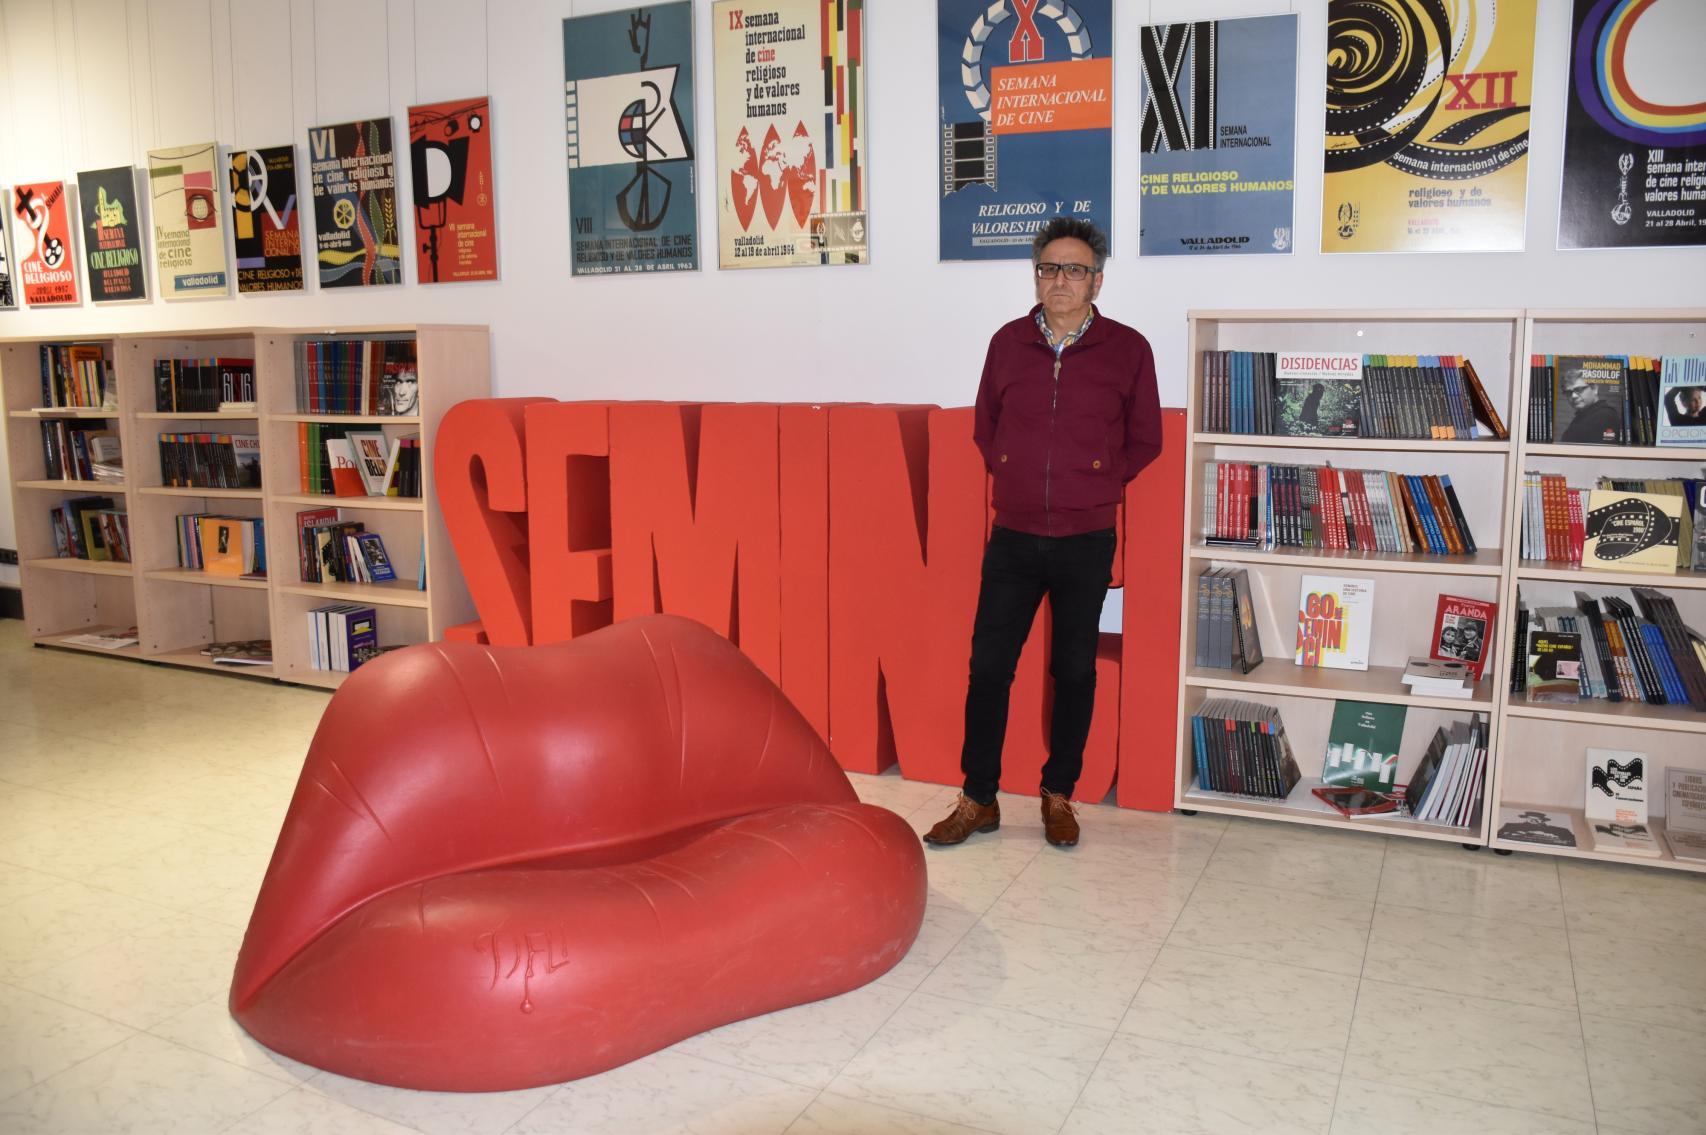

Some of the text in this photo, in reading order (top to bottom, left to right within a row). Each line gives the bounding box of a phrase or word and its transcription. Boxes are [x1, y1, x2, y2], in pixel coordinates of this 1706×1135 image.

[729, 10, 779, 30] IX semana
[745, 24, 806, 46] internacional
[746, 46, 776, 64] de cine
[746, 66, 786, 84] religioso
[998, 74, 1057, 91] SEMANA
[746, 82, 800, 102] y de valores
[1445, 71, 1518, 110] XII
[996, 89, 1106, 110] INTERNACIONAL
[746, 102, 787, 118] humanos
[996, 110, 1054, 126] DE CINE
[1220, 125, 1247, 136] SEMANA
[311, 128, 336, 160] VI
[1220, 136, 1272, 148] INTERNACIONAL
[312, 151, 393, 172] semana internacional
[1392, 140, 1528, 173] semana internacional de cine
[1648, 150, 1664, 163] XIII
[313, 174, 323, 184] de
[326, 170, 344, 183] cine
[348, 166, 384, 182] religioso
[1646, 162, 1682, 174] semana
[1141, 171, 1238, 184] CINE RELIGIOSO
[1646, 175, 1657, 188] de
[1659, 174, 1678, 188] cine
[314, 186, 324, 196] de
[327, 182, 358, 194] valores
[1141, 180, 1294, 195] Y DE VALORES HUMANOS
[1408, 186, 1482, 200] religioso y de
[1645, 189, 1678, 202] valores
[978, 200, 1092, 217] RELIGIOSO Y DE
[1408, 199, 1444, 208] valores
[1646, 210, 1695, 218] VALLADOLID
[576, 217, 592, 234] VIII
[972, 221, 1024, 234] VALORES
[164, 230, 190, 239] semana
[734, 235, 764, 245] valladolid
[1180, 236, 1250, 246] VALLADOLID
[168, 247, 192, 258] cine
[756, 247, 763, 256] de
[763, 246, 780, 256] abril
[24, 262, 42, 273] CINE
[160, 258, 192, 270] religioso
[25, 270, 72, 284] RELIGIOSO
[182, 275, 218, 287] valladolid
[1281, 357, 1358, 371] DISIDENCIAS
[1582, 370, 1620, 379] RASOULOF
[1306, 592, 1336, 619] 60
[1445, 605, 1488, 620] ARANDA
